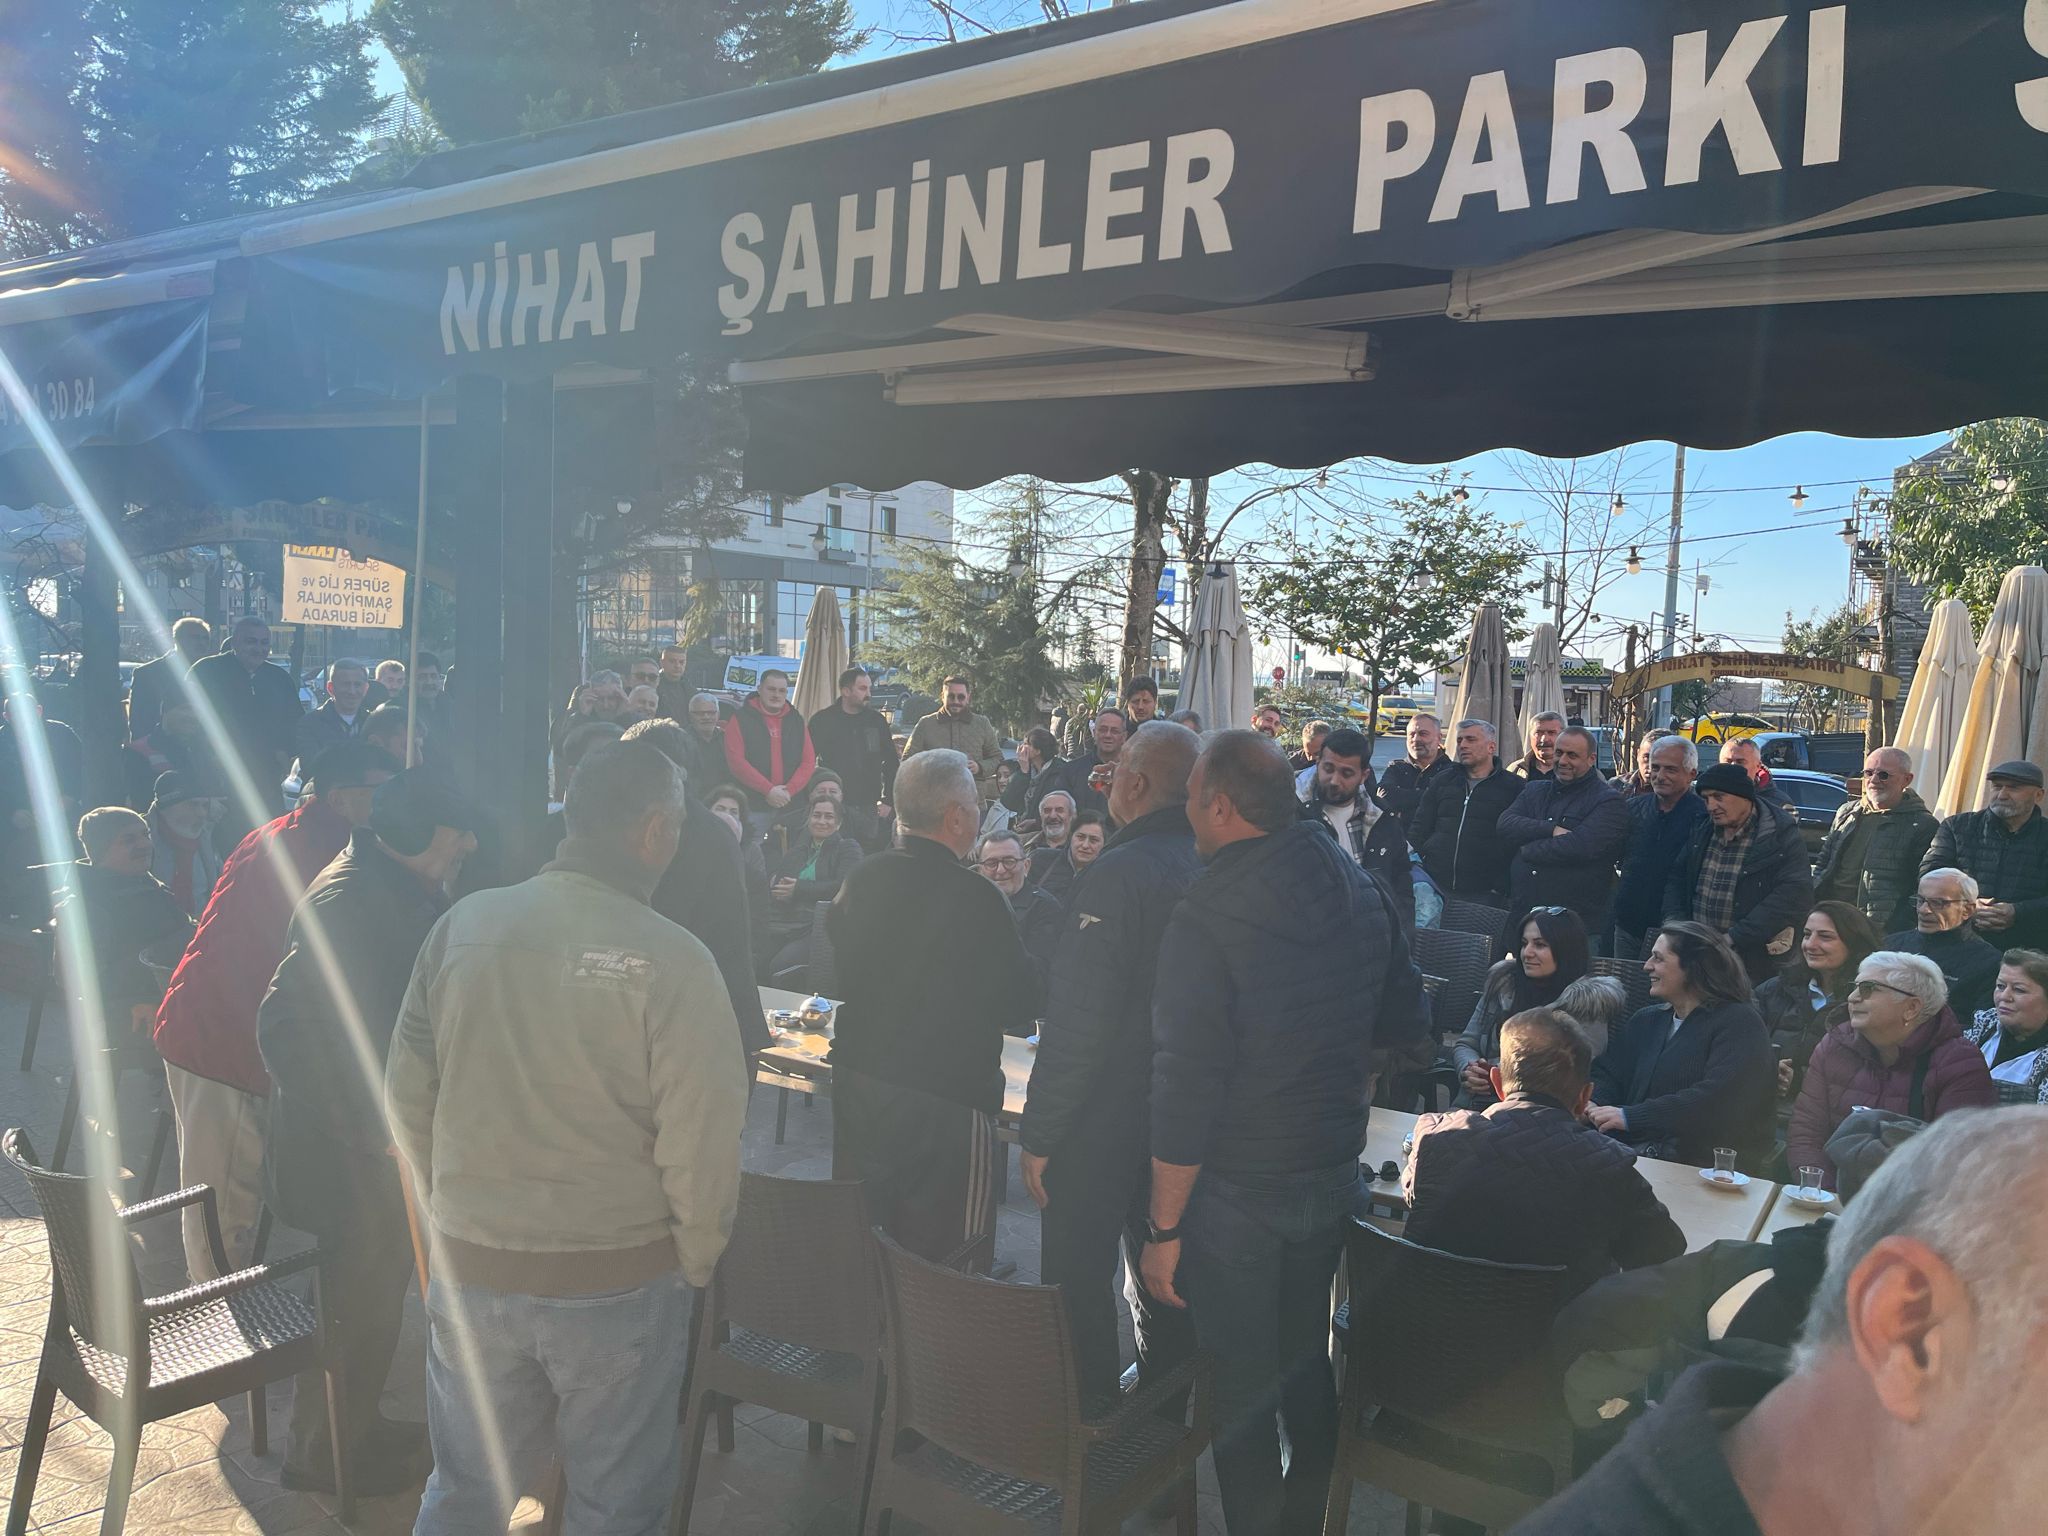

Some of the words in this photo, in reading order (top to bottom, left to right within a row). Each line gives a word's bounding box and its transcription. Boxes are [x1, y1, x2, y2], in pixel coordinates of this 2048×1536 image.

[440, 230, 656, 355] NİHAT
[717, 128, 1236, 336] ŞAHİNLER
[1352, 5, 1847, 234] PARKI
[74, 377, 95, 418] 84
